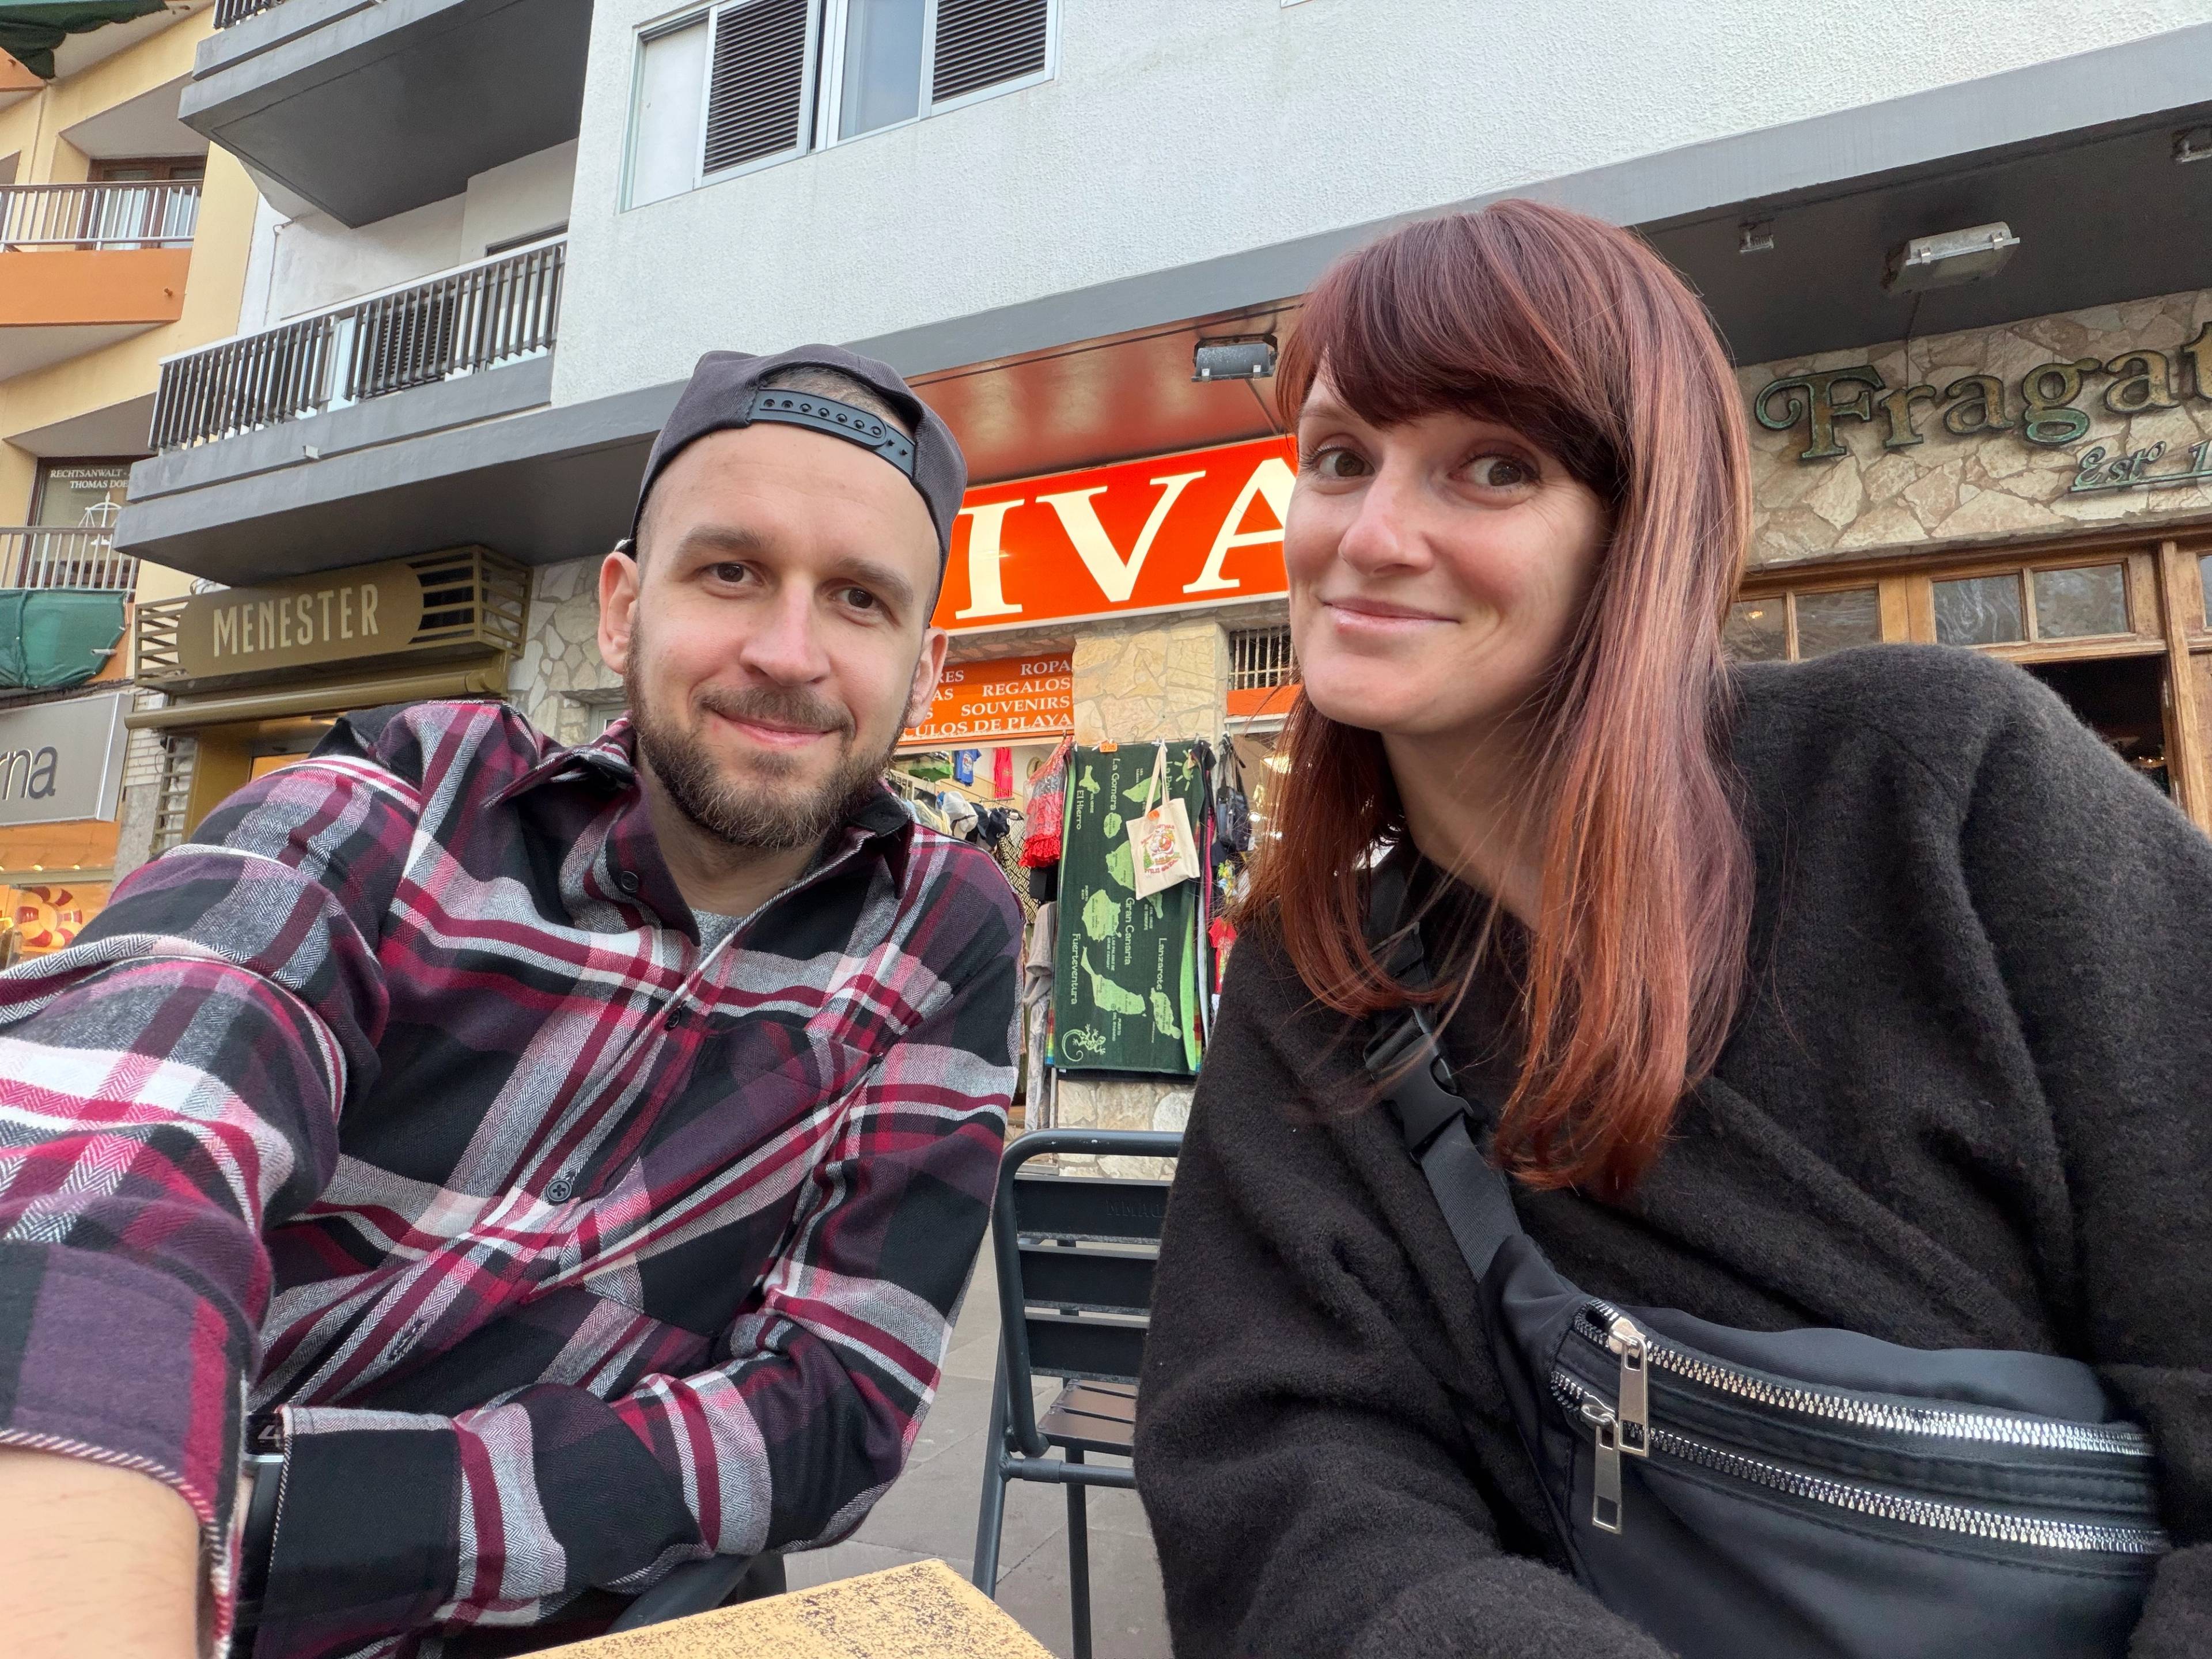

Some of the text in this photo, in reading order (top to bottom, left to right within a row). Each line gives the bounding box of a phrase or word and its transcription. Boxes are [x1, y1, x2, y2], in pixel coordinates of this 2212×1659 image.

[50, 463, 123, 478] RECHTSANWALT
[70, 480, 108, 488] THOMAS
[213, 584, 378, 657] MENESTER
[1020, 660, 1071, 676] ROPA
[982, 677, 1070, 697] REGALOS
[960, 696, 1070, 717] SOUVENIRS
[974, 719, 1002, 733] DE
[1007, 713, 1072, 730] PLAYA
[1109, 758, 1120, 810] La Gomera
[1075, 790, 1084, 830] El Hierro
[1124, 897, 1135, 965] Gran Canaria
[1070, 933, 1081, 1006] Fuerteventura
[1156, 937, 1168, 990] Lanzarote
